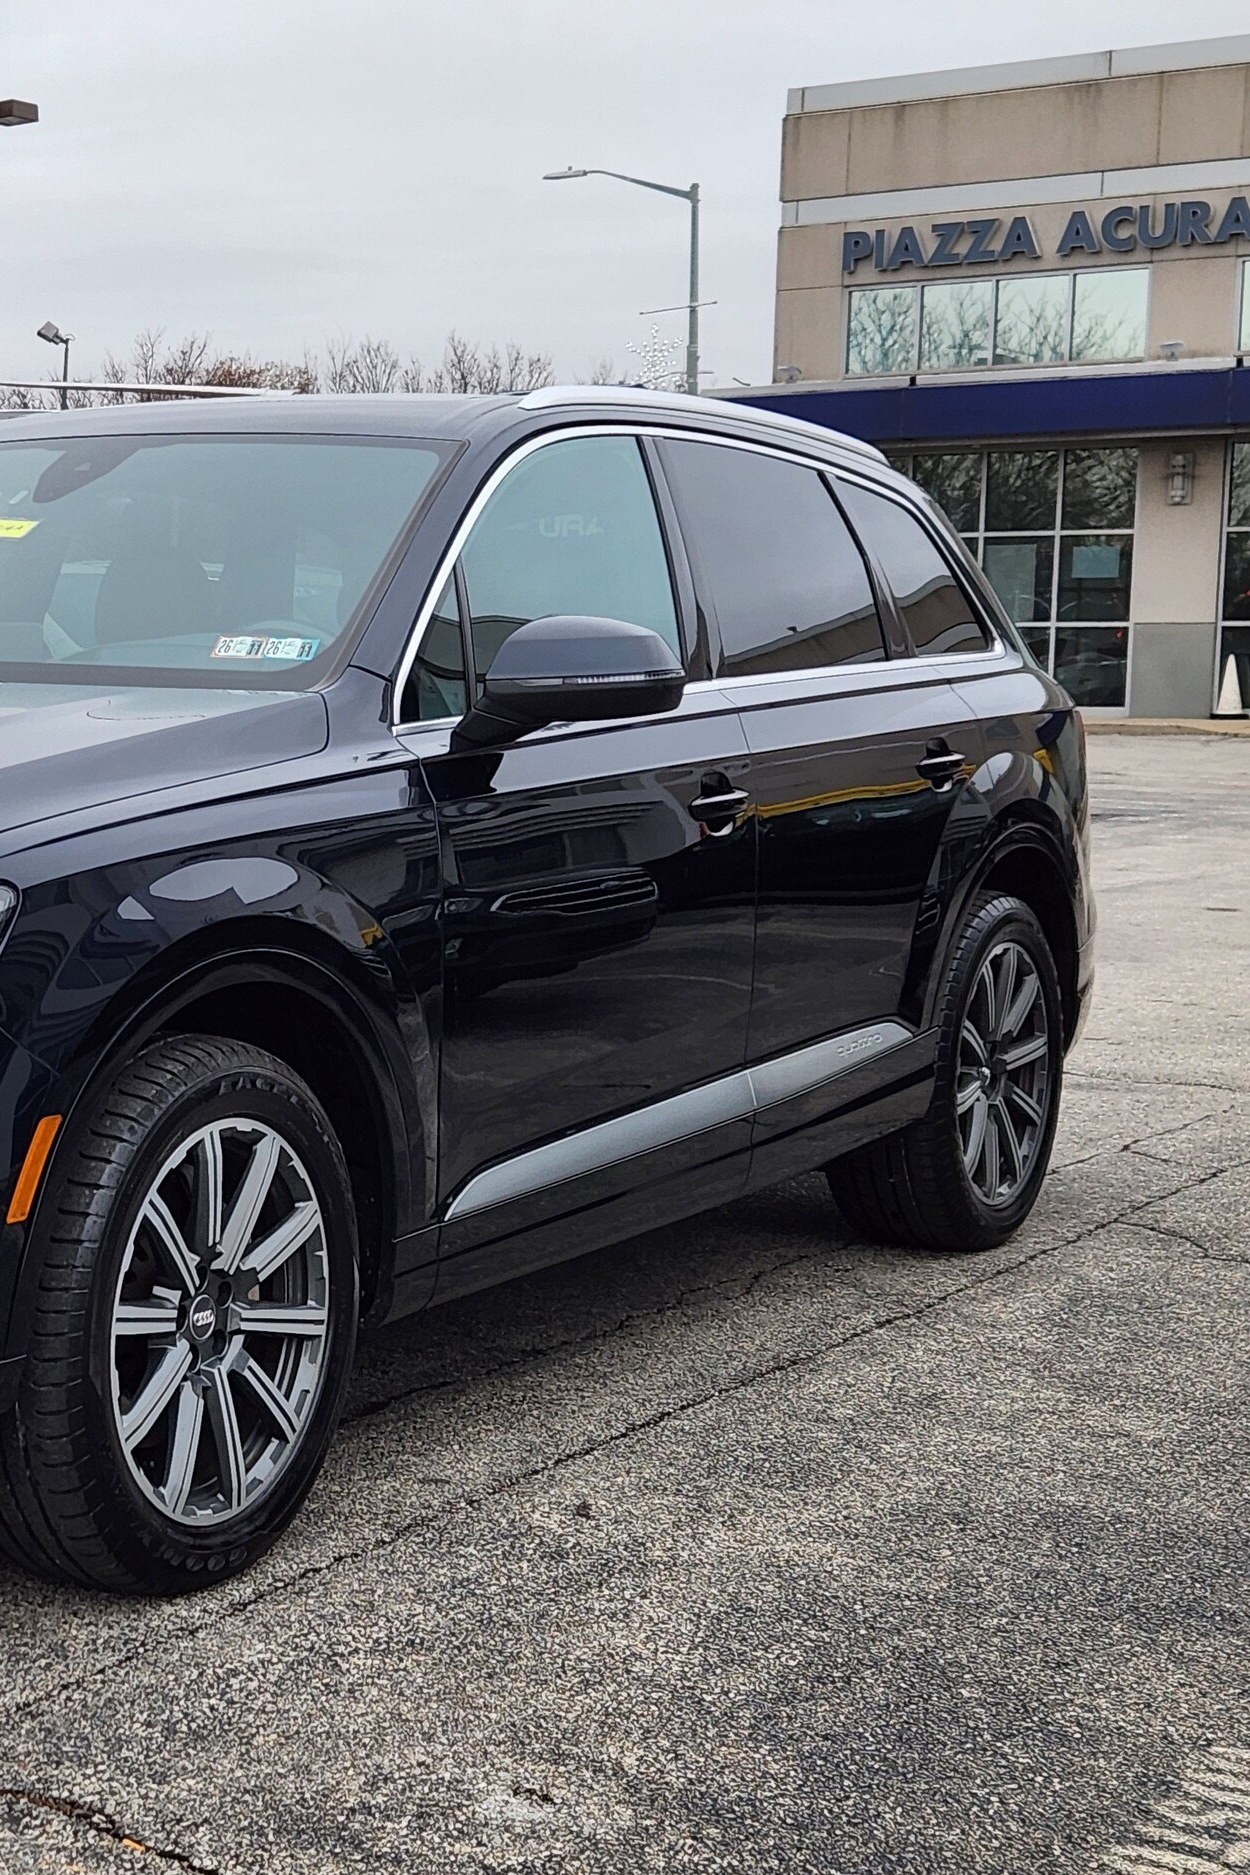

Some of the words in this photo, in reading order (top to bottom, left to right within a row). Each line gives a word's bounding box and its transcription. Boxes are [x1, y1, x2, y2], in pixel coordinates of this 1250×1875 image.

[842, 216, 1043, 273] PIAZZA
[1055, 196, 1250, 255] ACURA
[218, 640, 232, 654] 26
[248, 640, 262, 656] 11
[266, 641, 281, 655] 26
[297, 641, 313, 658] 11
